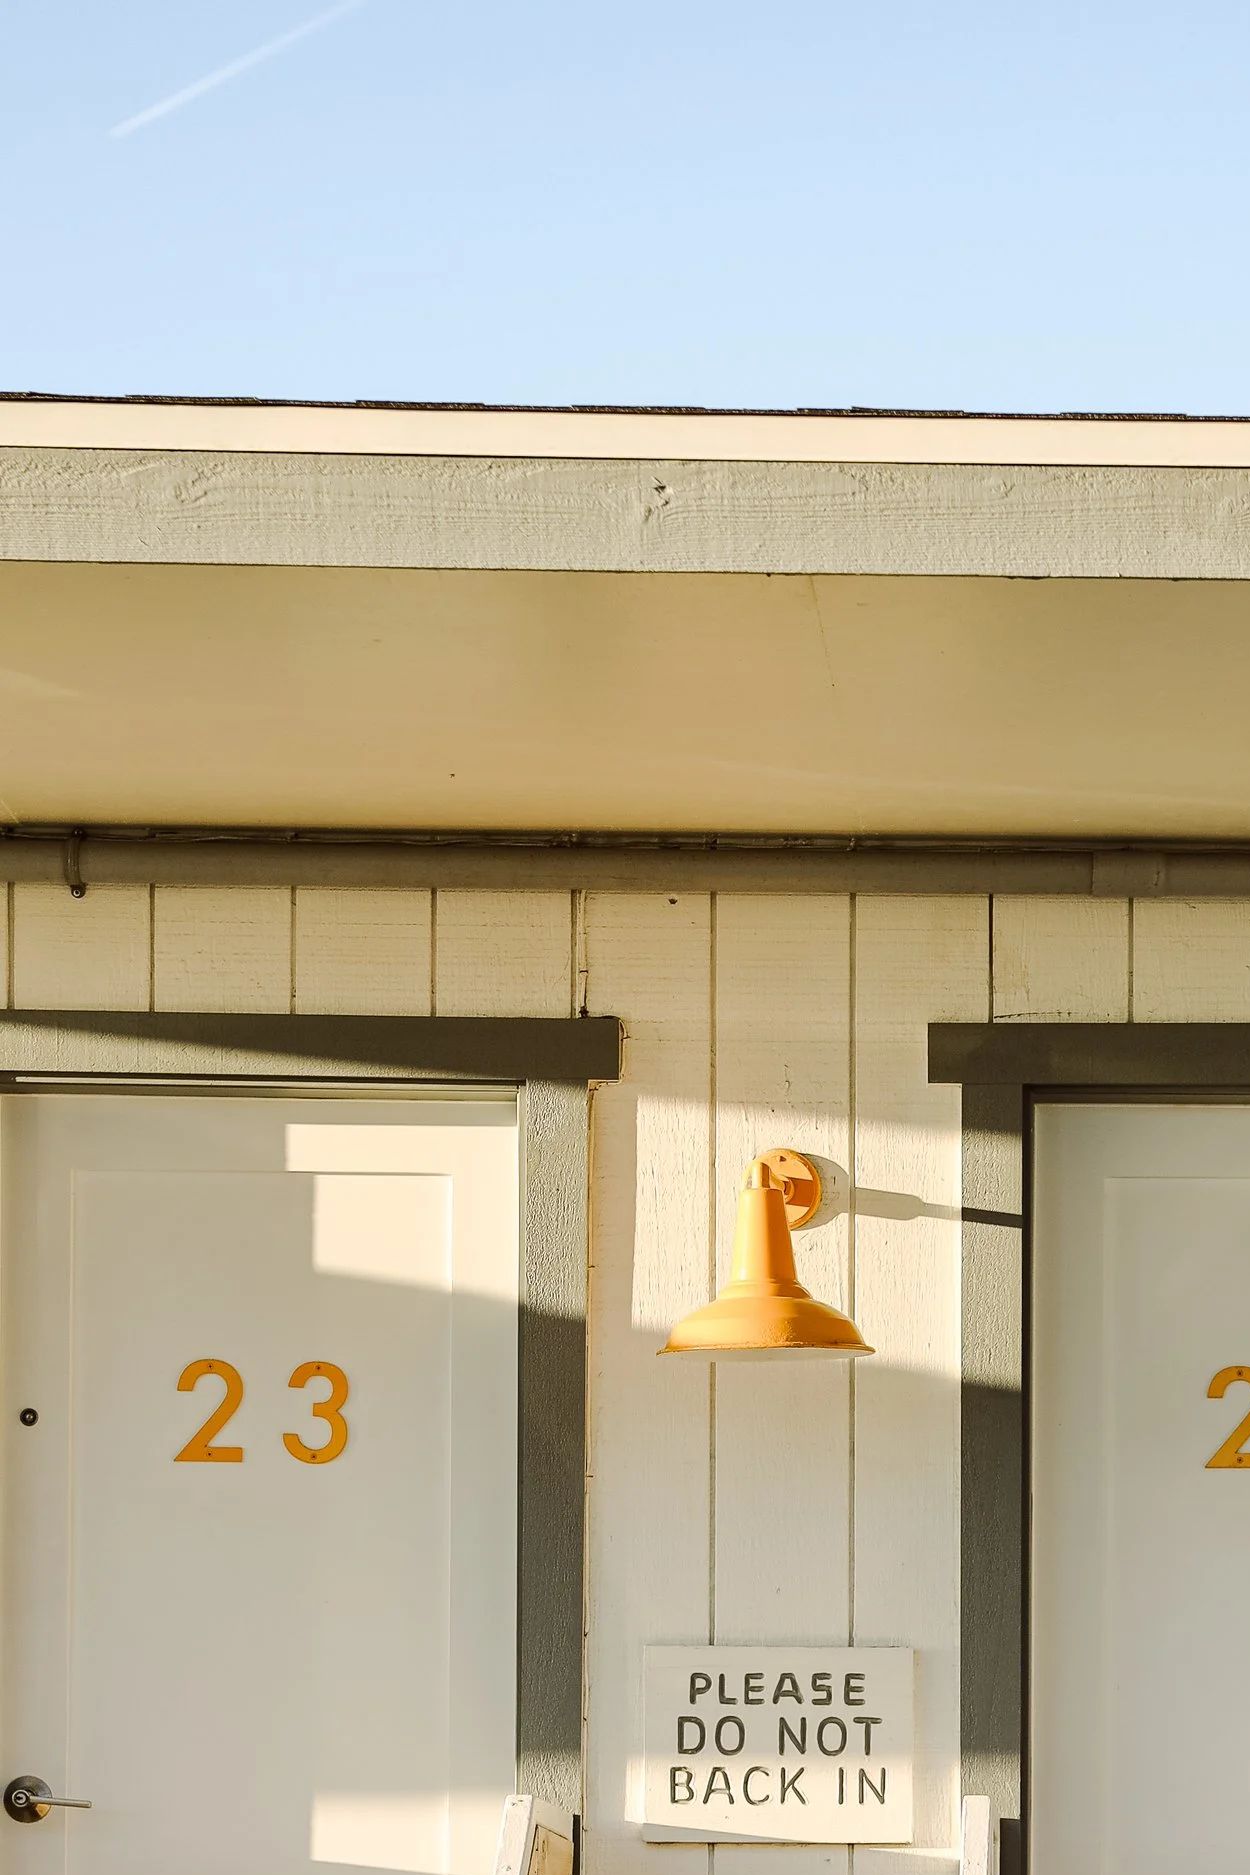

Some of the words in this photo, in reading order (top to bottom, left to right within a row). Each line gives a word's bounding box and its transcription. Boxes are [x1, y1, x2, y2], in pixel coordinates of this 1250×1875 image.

[174, 1358, 350, 1465] 23
[689, 1672, 866, 1706] PLEASE
[677, 1715, 746, 1756] DO
[778, 1716, 883, 1757] NOT
[669, 1766, 807, 1806] BACK
[838, 1767, 886, 1805] IN
